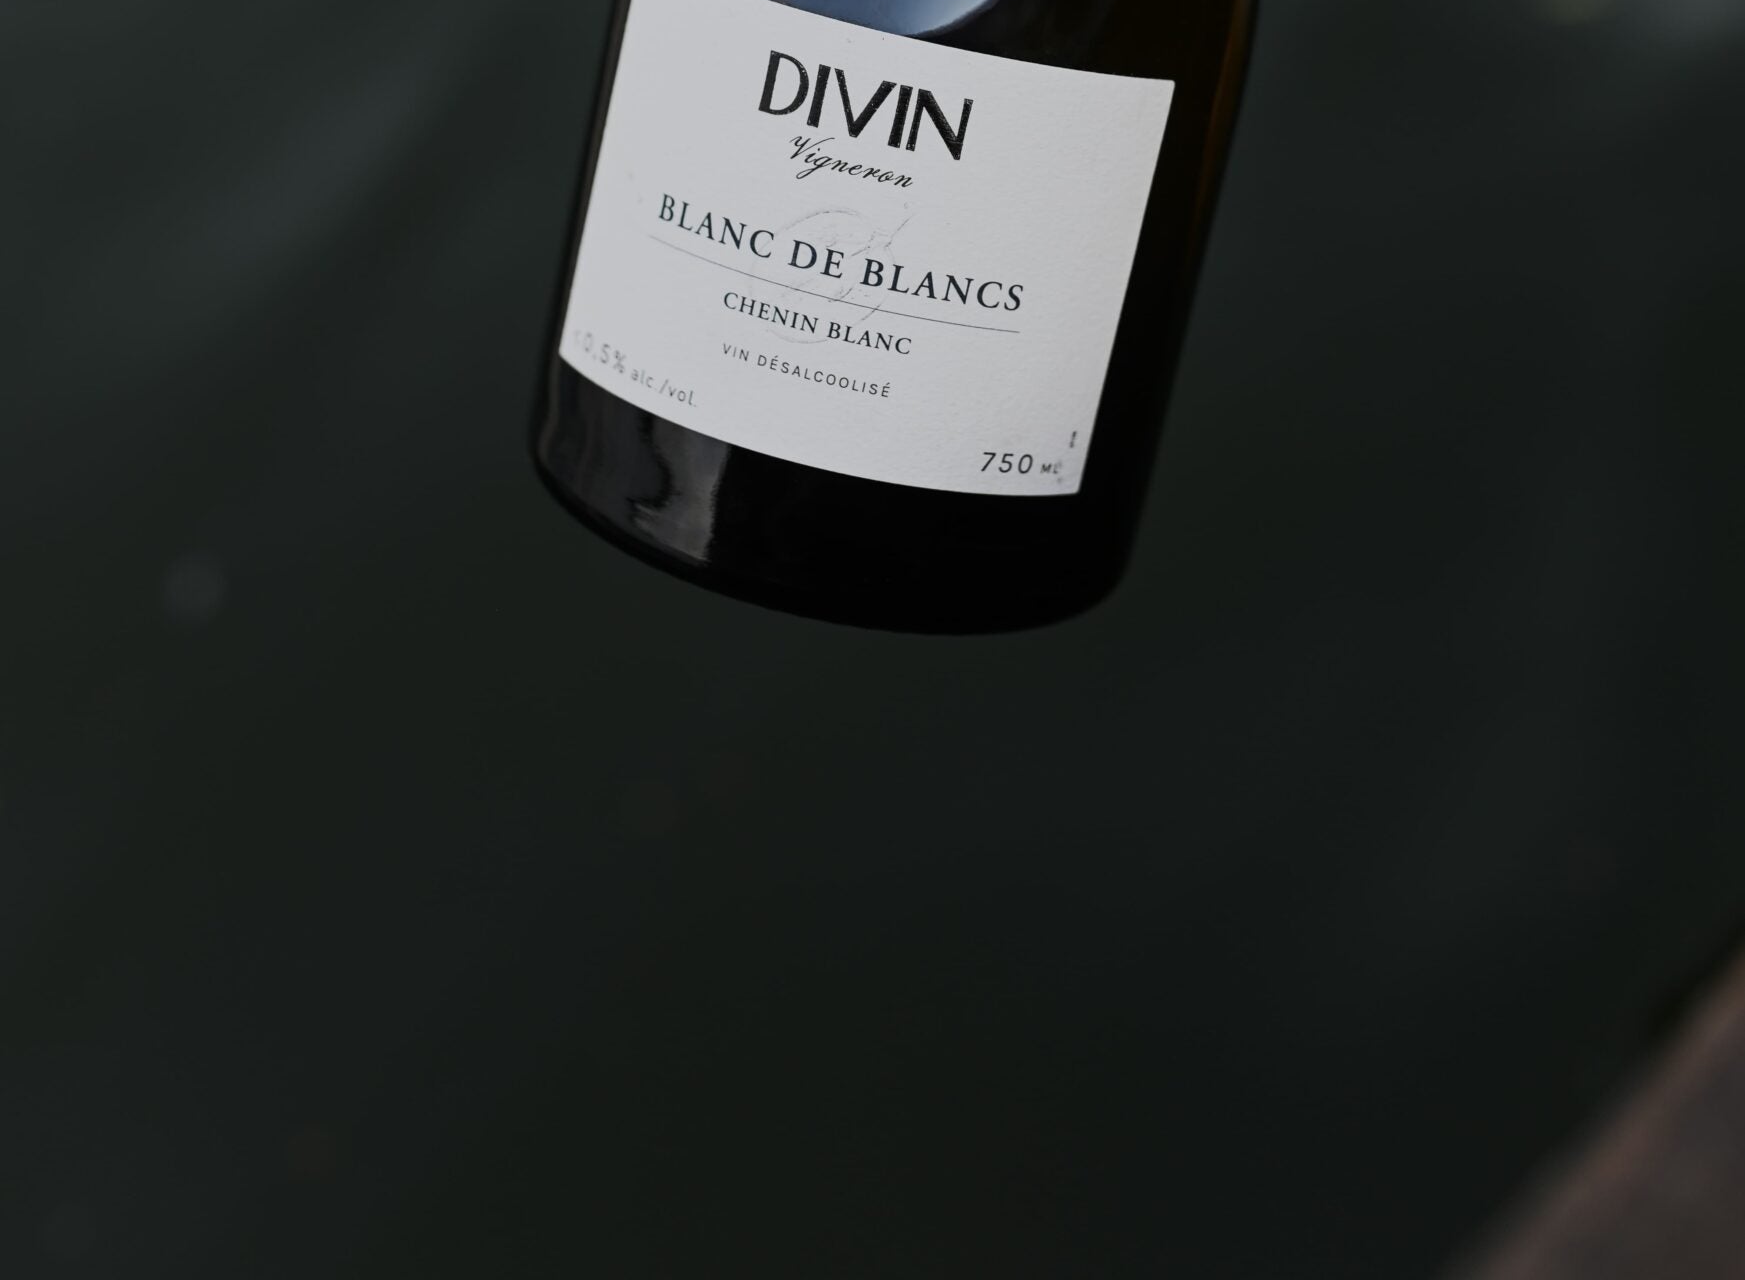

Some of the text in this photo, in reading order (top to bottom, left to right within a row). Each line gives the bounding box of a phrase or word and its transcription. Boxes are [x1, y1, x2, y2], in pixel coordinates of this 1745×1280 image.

[758, 50, 974, 161] DIVIN
[788, 135, 914, 188] Vigneron
[657, 193, 1024, 312] BLANC DE BLANCS
[723, 291, 913, 356] CHENIN BLANC
[723, 343, 892, 399] VIN DÉSALCOOLISÉ
[980, 451, 1034, 474] 750
